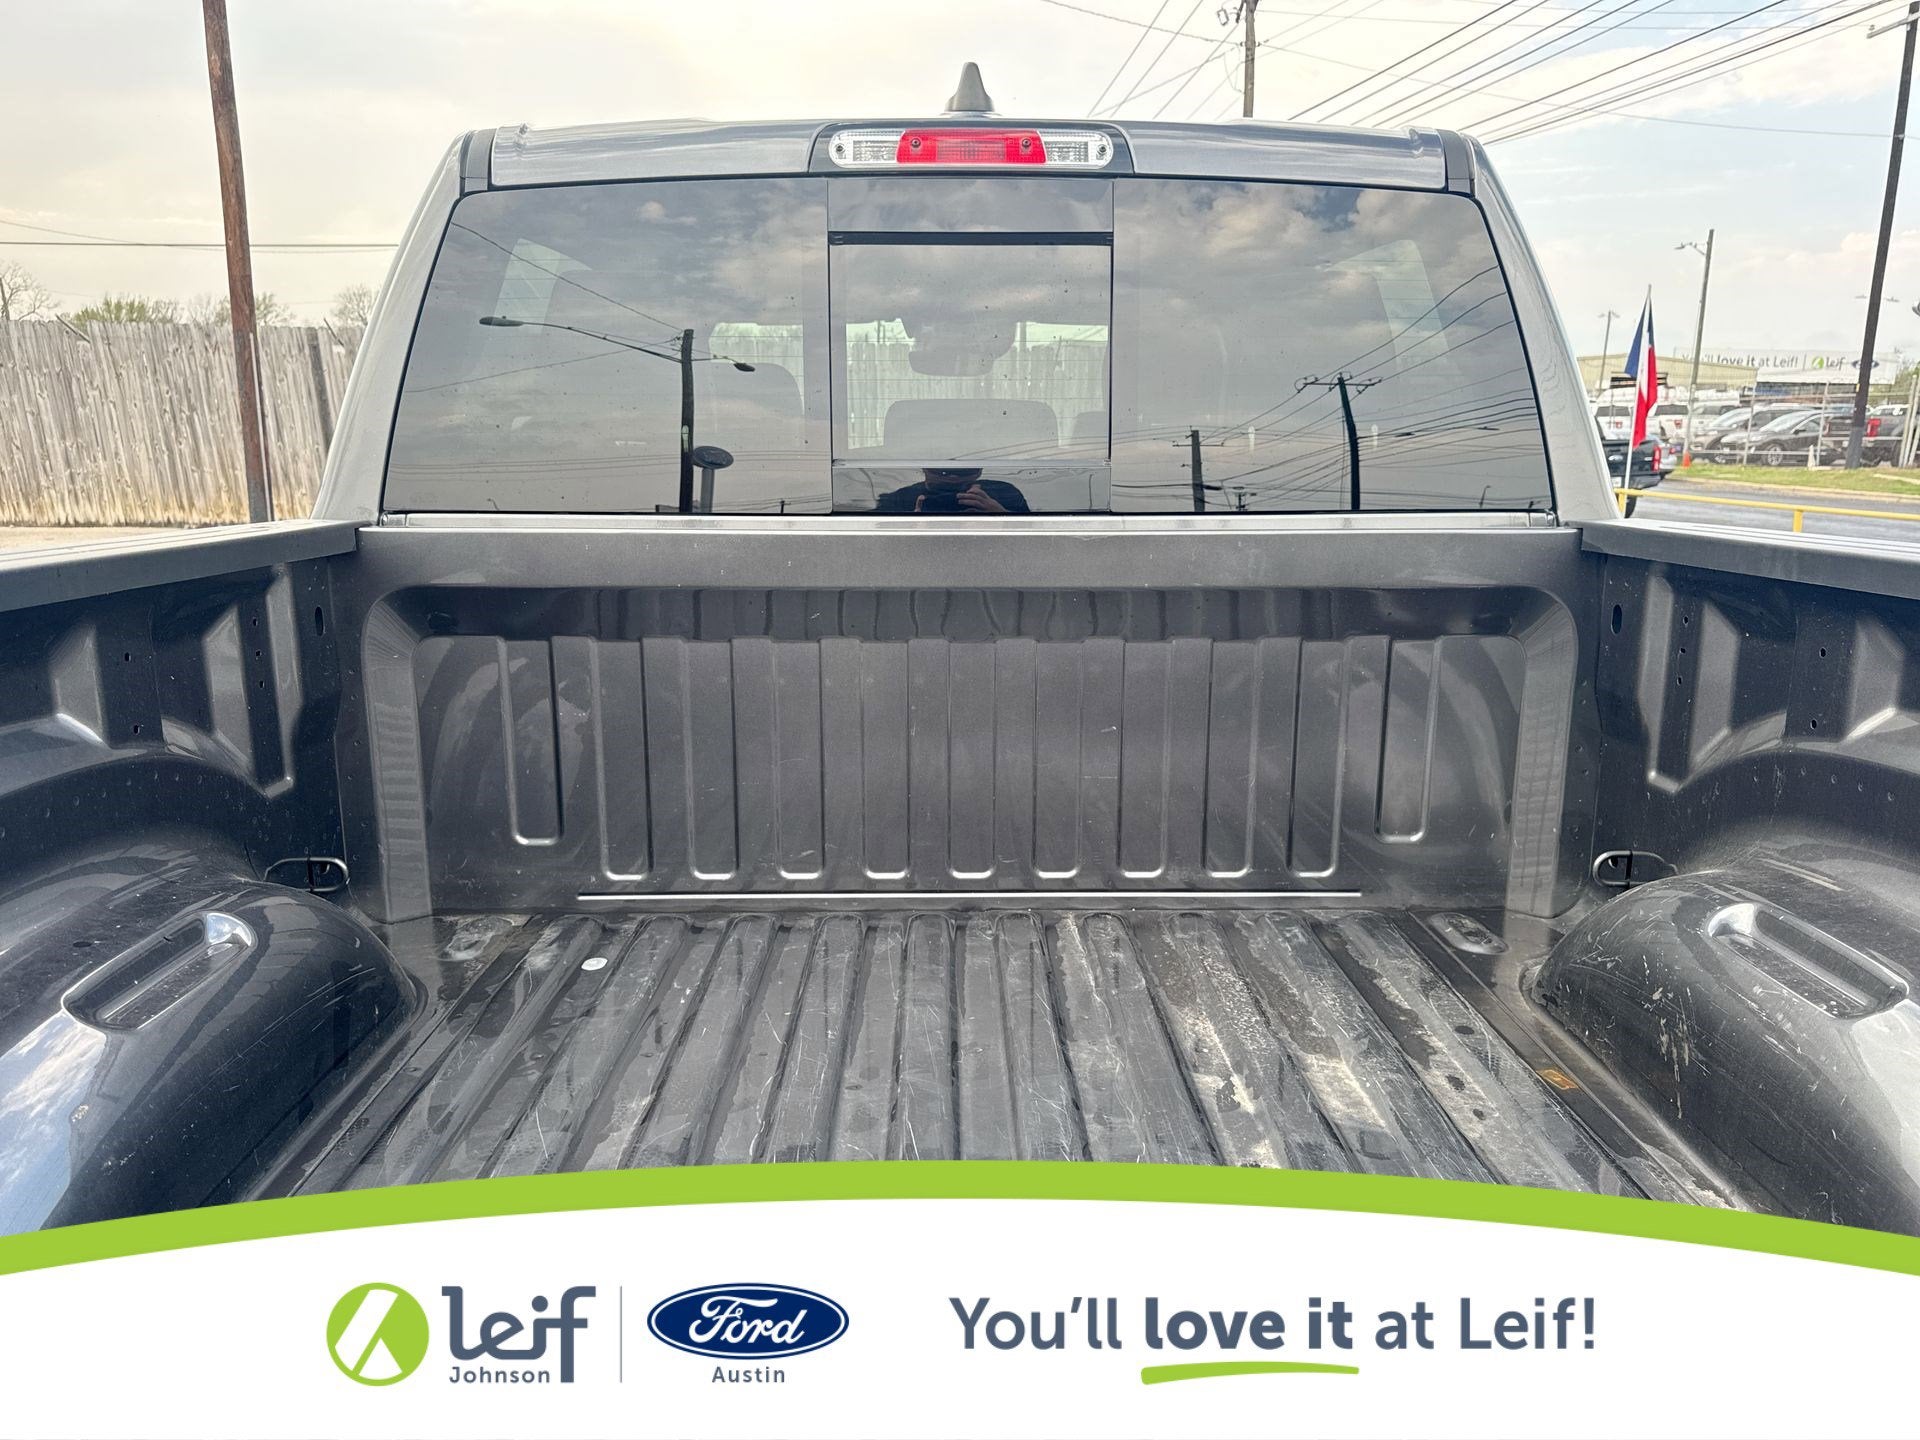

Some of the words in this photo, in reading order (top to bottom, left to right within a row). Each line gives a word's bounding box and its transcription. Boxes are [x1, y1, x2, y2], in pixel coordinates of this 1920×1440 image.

[1682, 353, 1713, 363] Y’ll
[1717, 354, 1743, 365] love
[1746, 354, 1756, 366] it
[1758, 356, 1769, 367] at
[1773, 355, 1798, 368] Leif!
